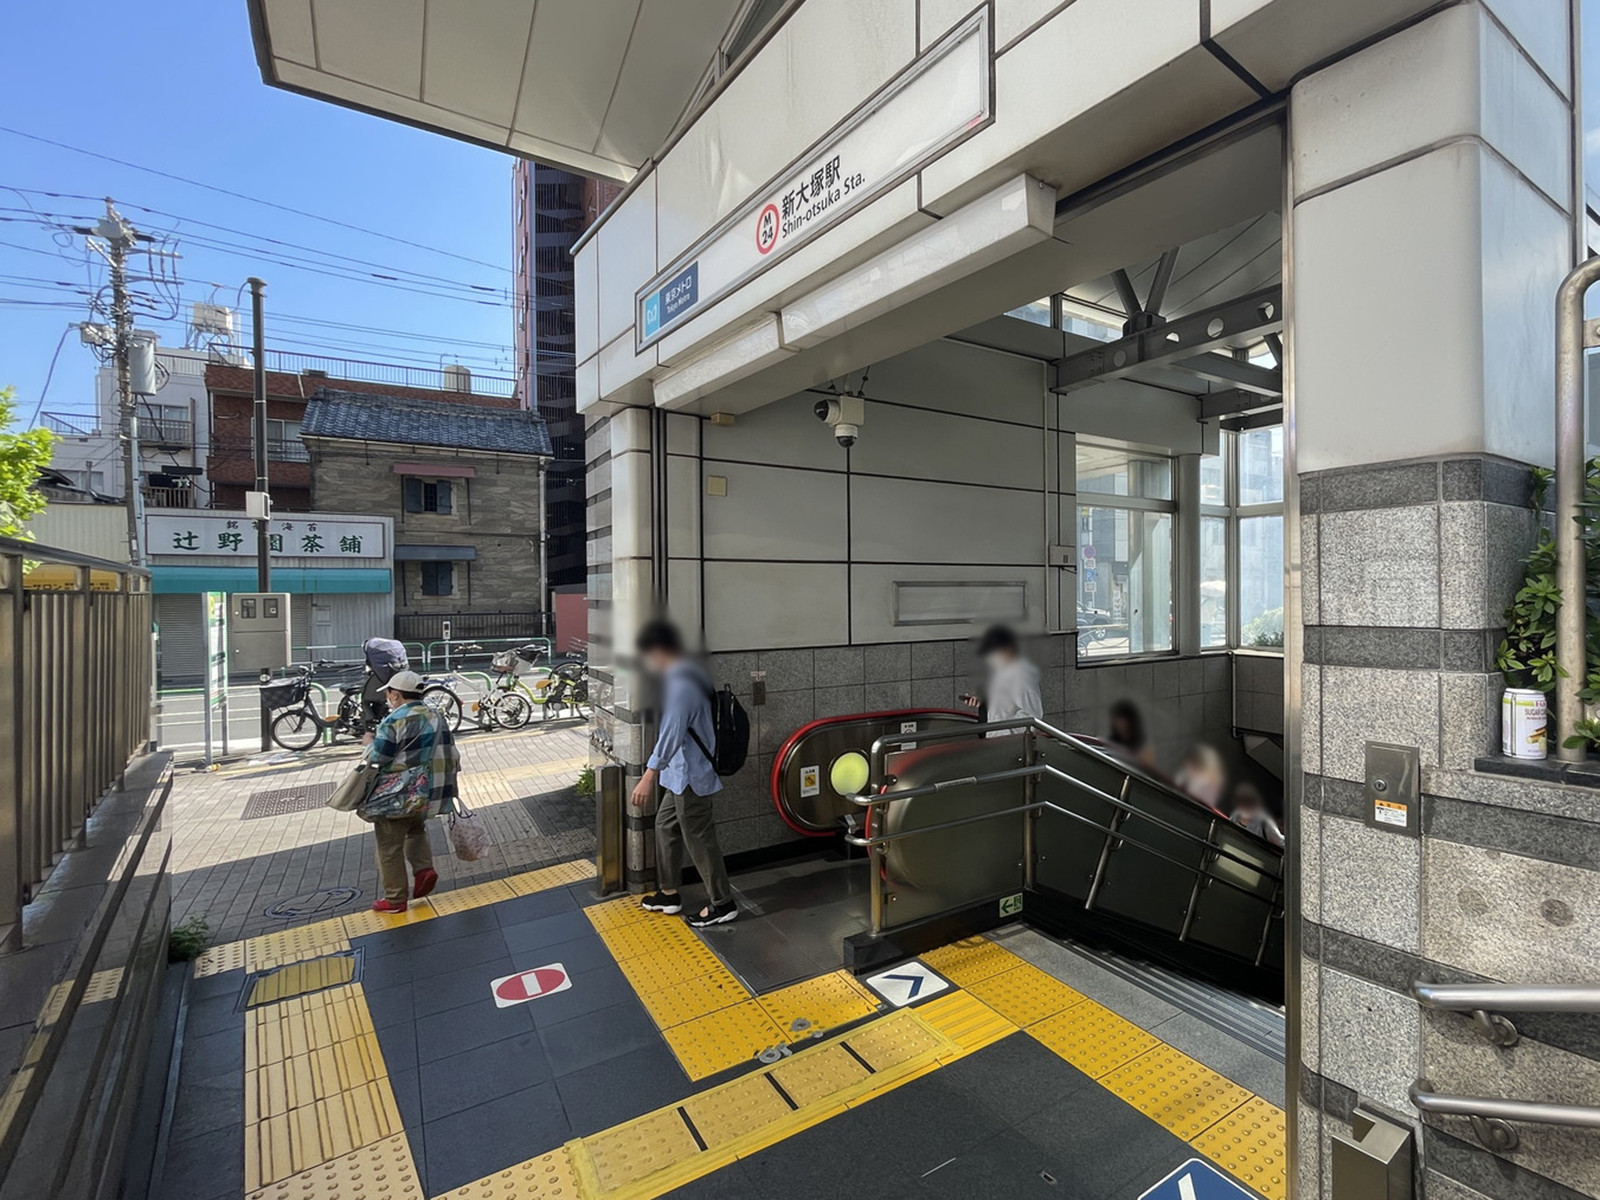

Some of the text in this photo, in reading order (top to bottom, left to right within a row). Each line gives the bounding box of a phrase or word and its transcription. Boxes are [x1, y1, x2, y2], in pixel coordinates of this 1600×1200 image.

[782, 155, 840, 220] 新大塚駅
[763, 212, 772, 229] M
[782, 173, 865, 239] Shin-otsuka Sta.
[762, 226, 773, 245] 24
[665, 275, 692, 305] 東京メトロ
